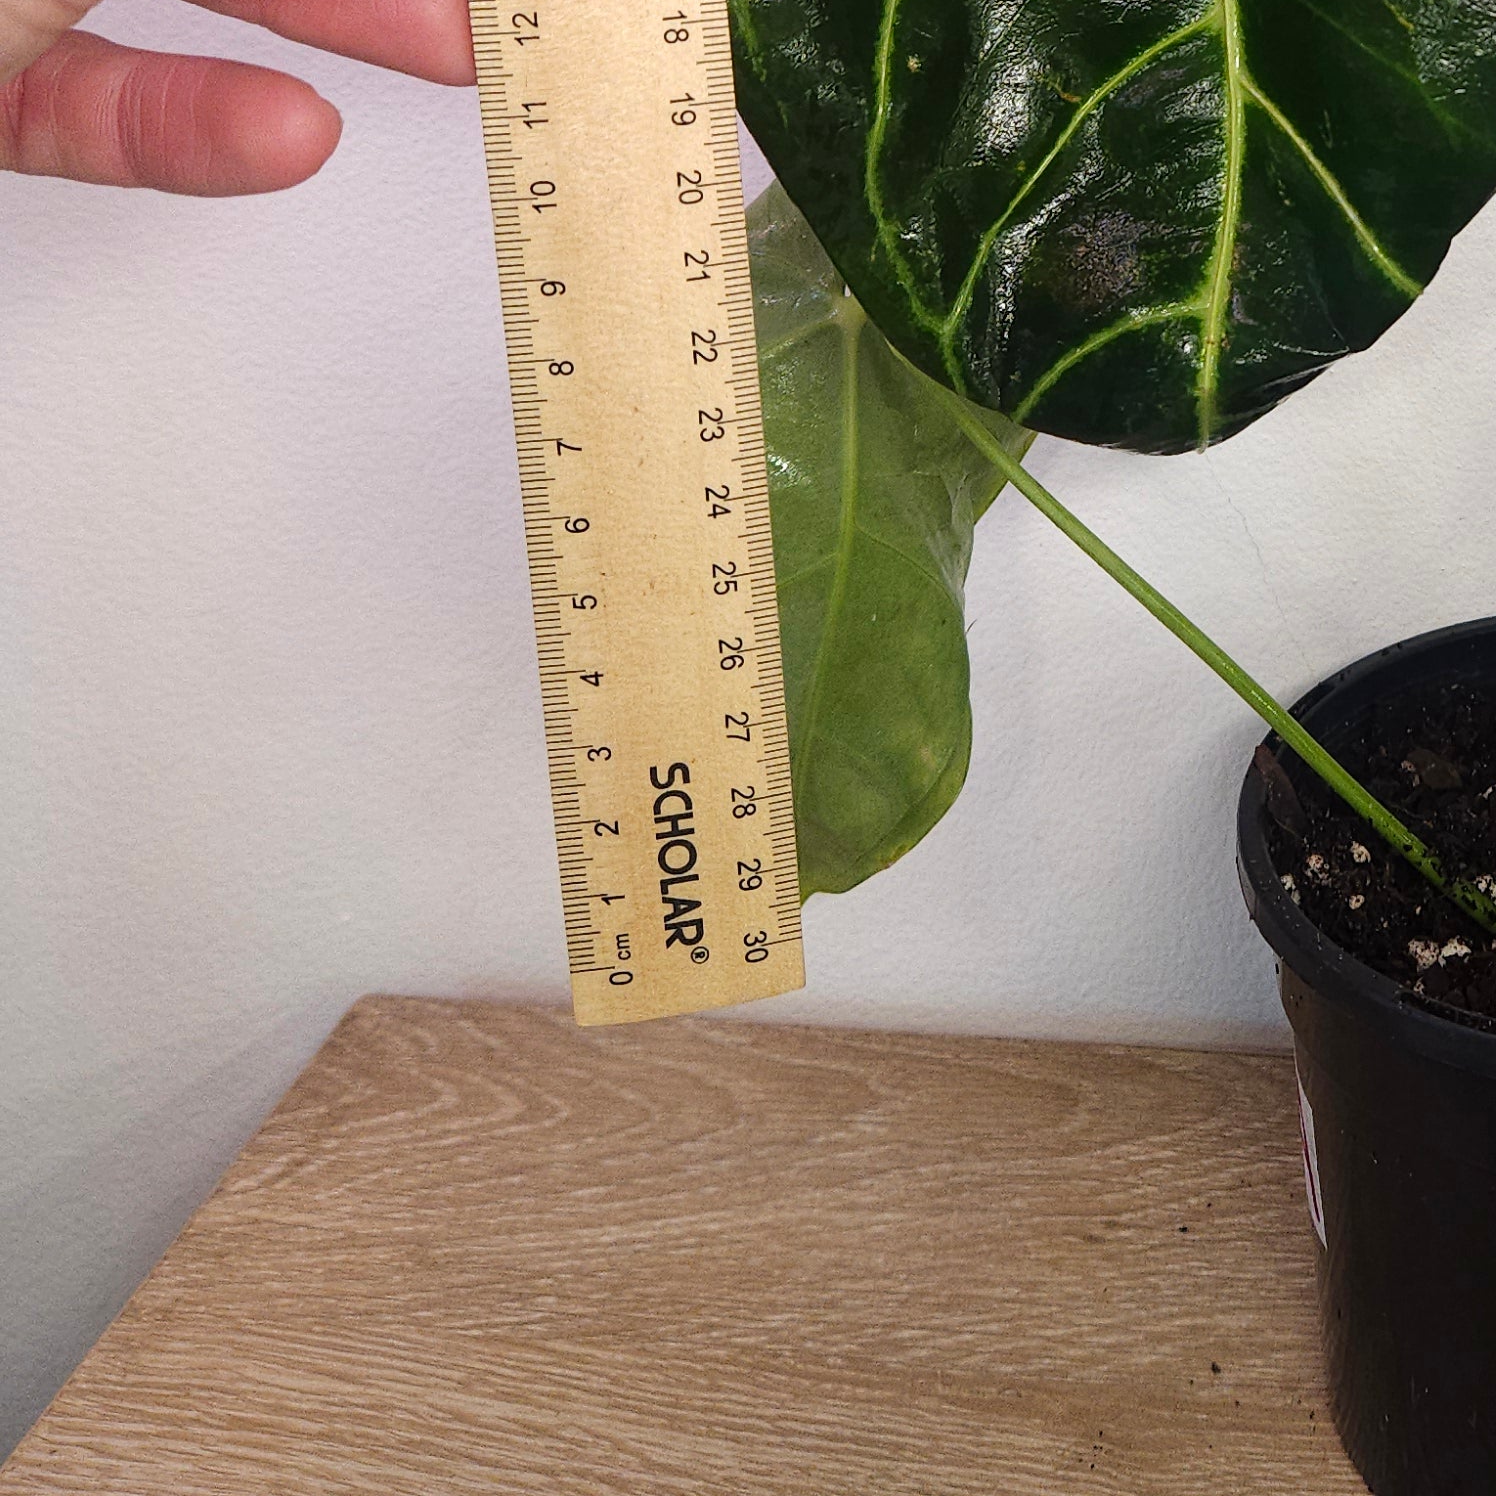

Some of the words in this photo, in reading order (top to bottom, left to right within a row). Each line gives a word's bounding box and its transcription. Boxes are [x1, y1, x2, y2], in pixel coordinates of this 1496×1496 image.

[511, 11, 540, 47] 12
[661, 9, 690, 44] 18
[520, 101, 549, 130] 11
[669, 91, 698, 127] 19
[529, 180, 558, 214] 10
[676, 169, 704, 205] 20
[683, 249, 711, 282] 21
[540, 280, 566, 297] 9
[690, 329, 718, 366] 22
[548, 360, 575, 376] 8
[697, 407, 725, 443] 23
[556, 439, 583, 457] 7
[704, 484, 732, 520] 24
[564, 517, 591, 534] 6
[711, 561, 739, 596] 25
[571, 594, 598, 610] 5
[717, 636, 745, 671] 26
[579, 671, 605, 687] 4
[724, 711, 751, 743] 27
[586, 745, 612, 762] 3
[730, 785, 757, 819] 28
[593, 819, 620, 837] 2
[736, 858, 763, 892] 29
[600, 894, 626, 907] 1
[616, 932, 632, 962] cm
[743, 930, 769, 964] 30
[608, 970, 634, 986] 0
